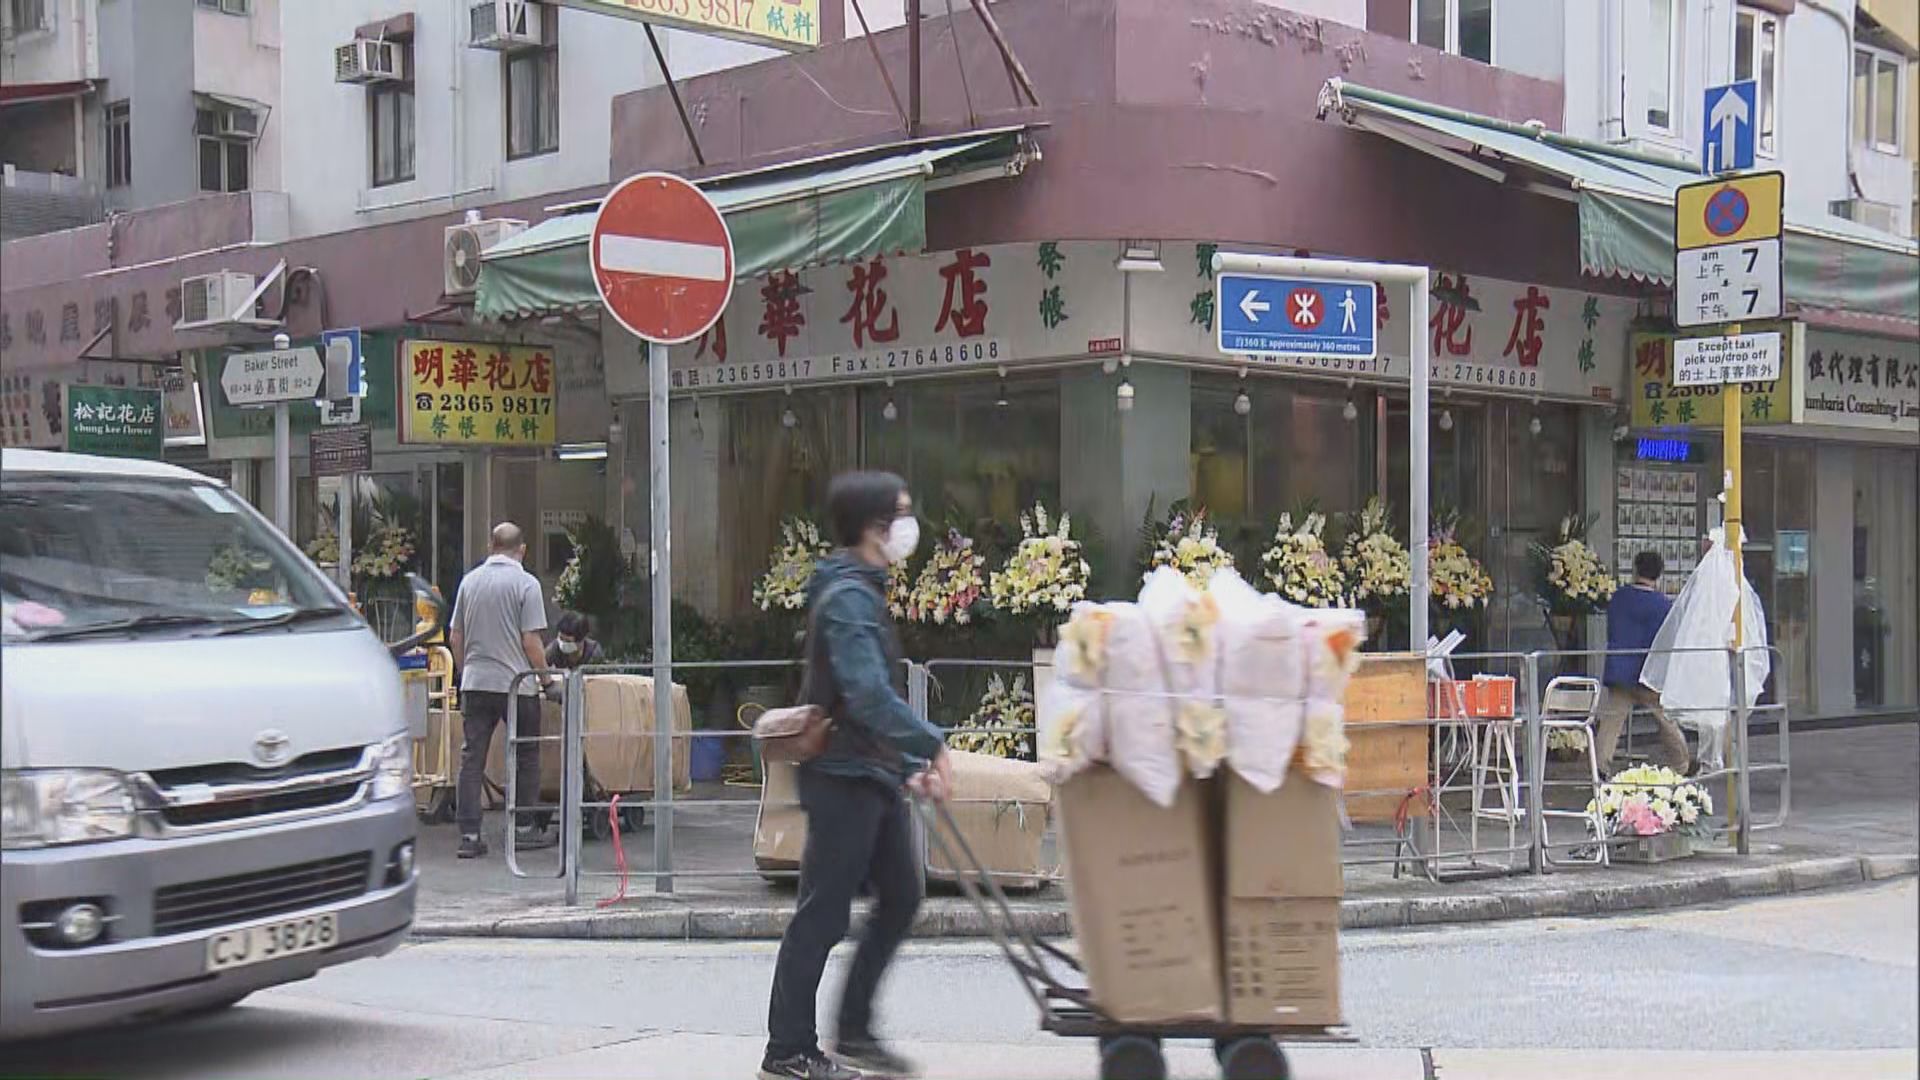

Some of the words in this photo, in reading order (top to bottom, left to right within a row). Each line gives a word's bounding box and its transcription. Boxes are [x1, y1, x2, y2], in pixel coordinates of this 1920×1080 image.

[1701, 252, 1719, 261] am
[1741, 249, 1759, 273] 7
[1696, 264, 1724, 279] 上午
[693, 249, 992, 364] 華花店
[1701, 292, 1719, 304] pm
[1741, 289, 1759, 315] 7
[1269, 340, 1321, 352] approximately
[1322, 341, 1335, 351] 360
[1336, 343, 1361, 352] metres
[1697, 341, 1733, 354] Except
[1735, 339, 1755, 348] taxi
[244, 359, 268, 372] Baker
[271, 355, 298, 370] Street
[1684, 355, 1706, 366] pick
[1708, 353, 1749, 364] up/drop
[1751, 350, 1768, 360] off
[413, 347, 552, 394] 明華花店
[1679, 364, 1773, 382] 的士上落客除外
[74, 402, 155, 424] 松記花店
[440, 394, 494, 413] 2365
[503, 396, 552, 415] 9817
[1847, 394, 1897, 423] Consulting
[74, 423, 103, 434] chung
[105, 425, 121, 433] kee
[123, 426, 152, 434] flower
